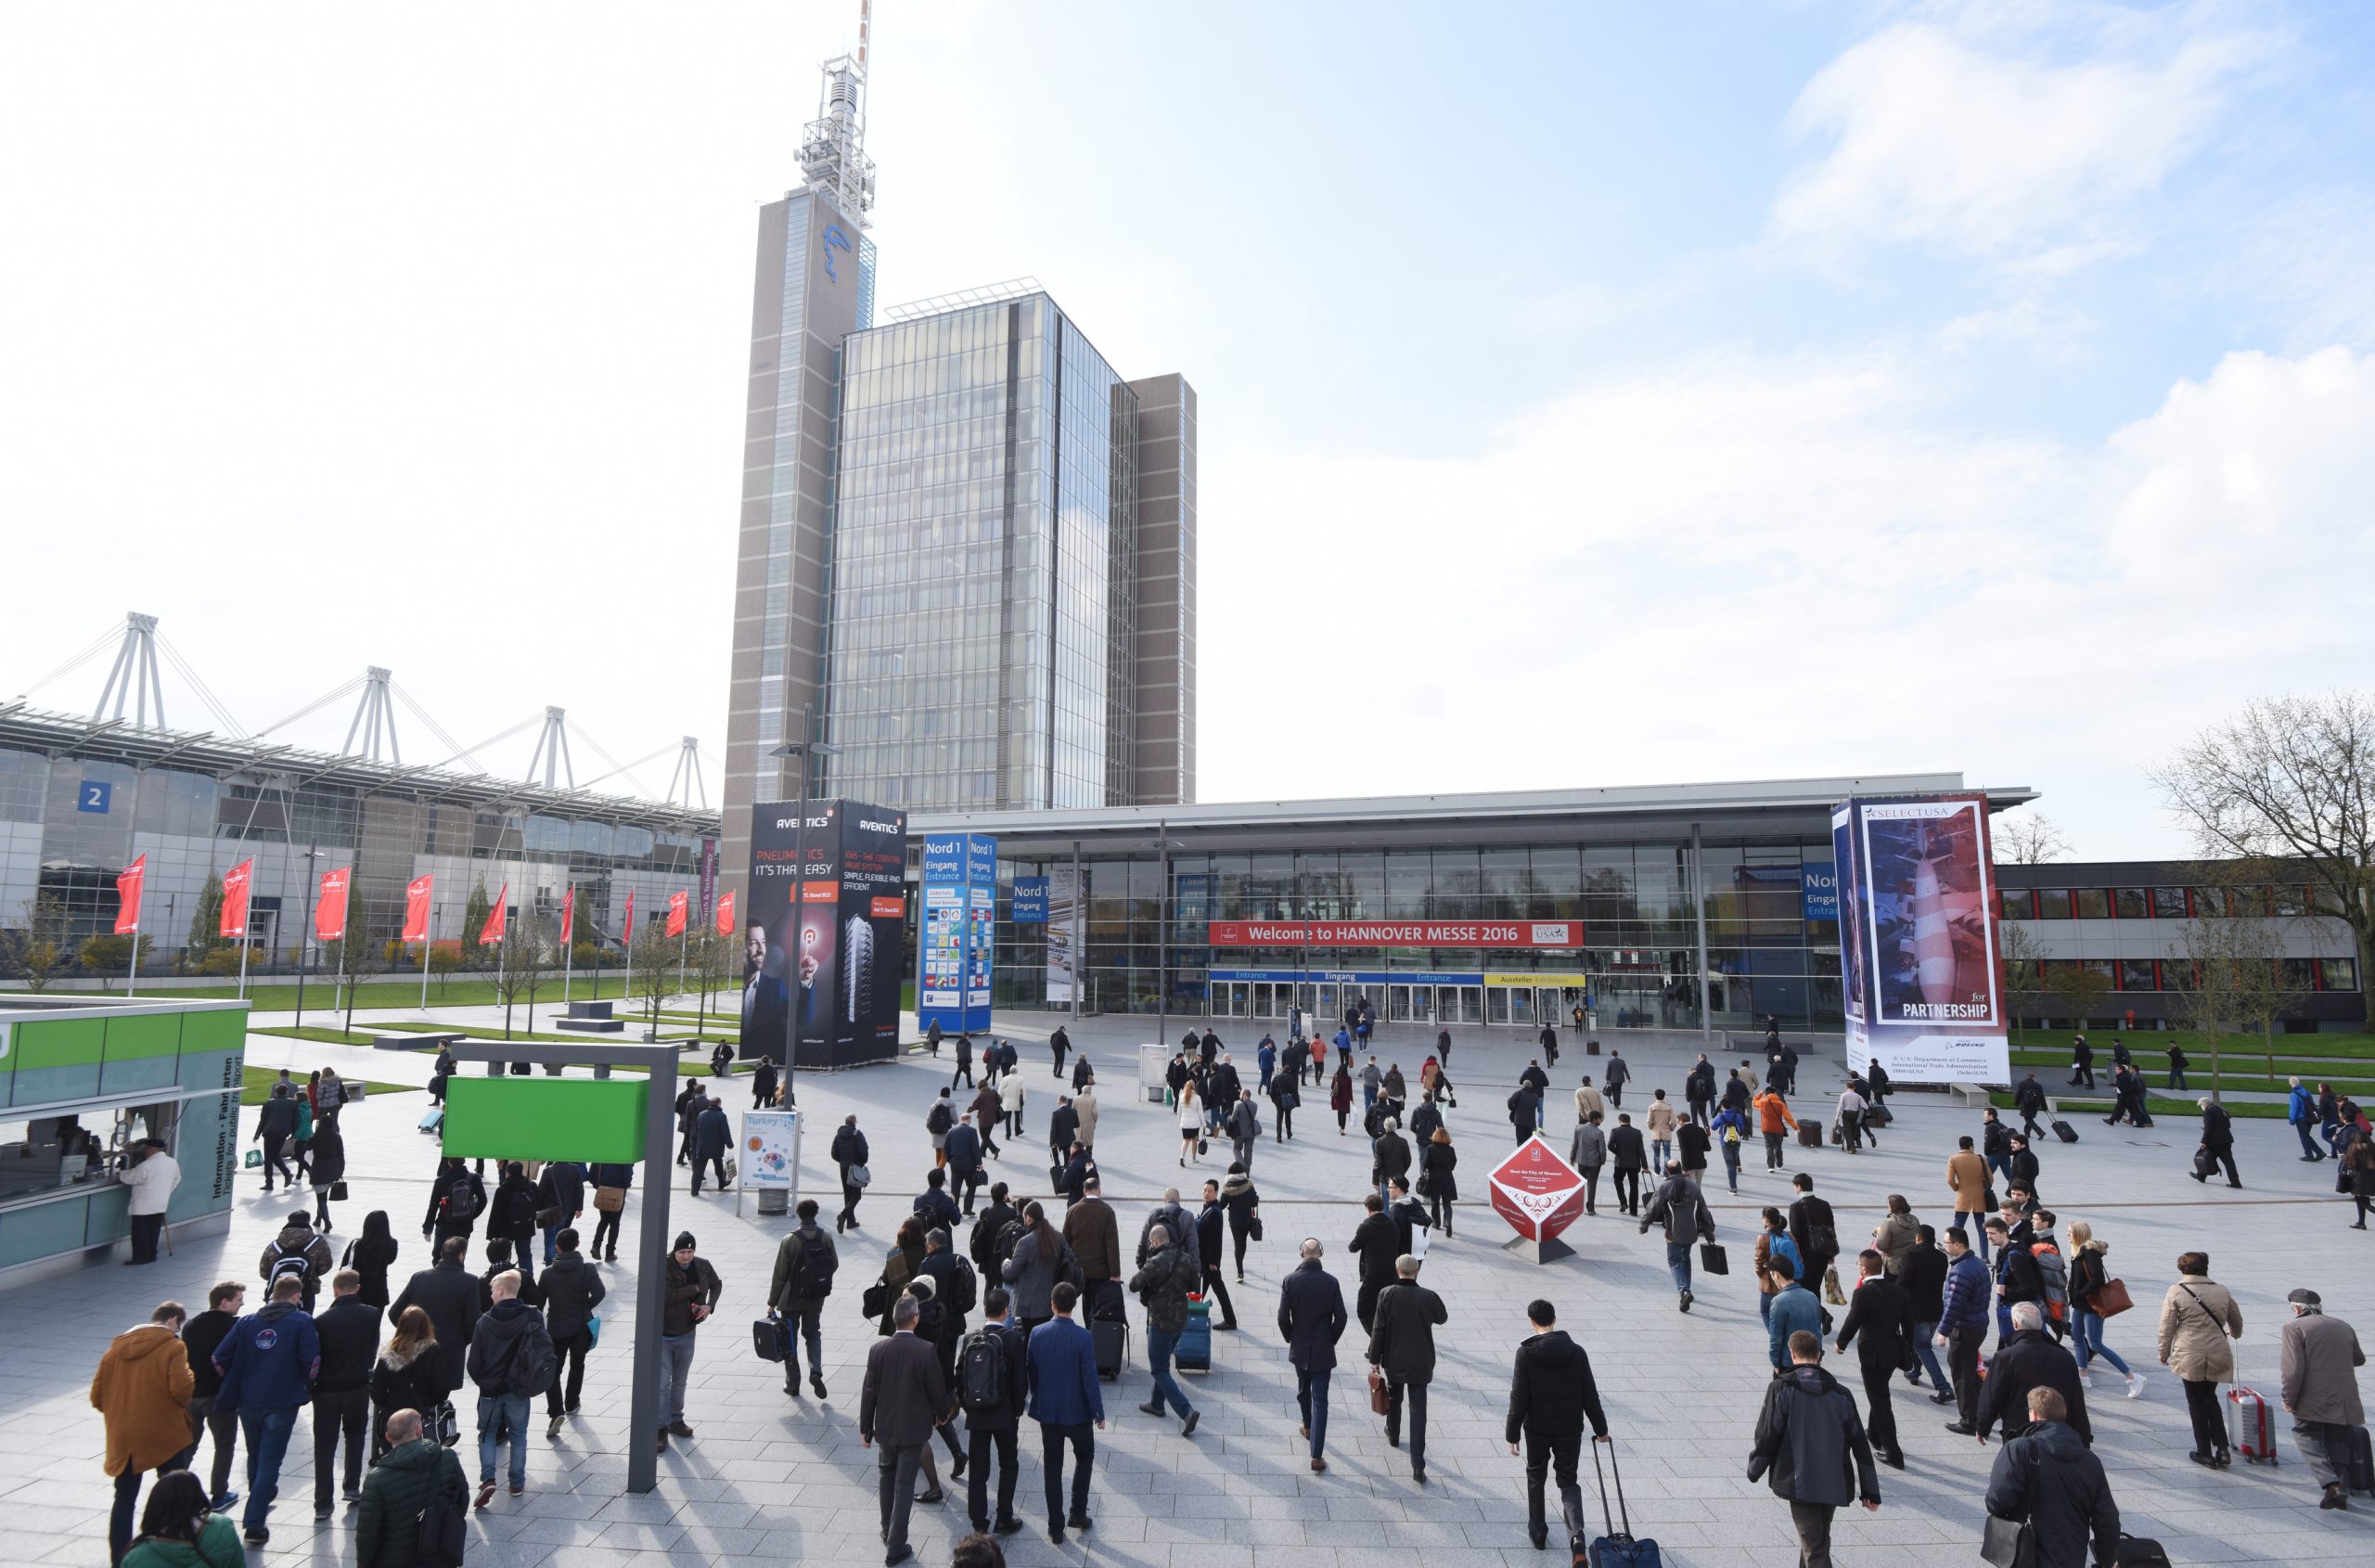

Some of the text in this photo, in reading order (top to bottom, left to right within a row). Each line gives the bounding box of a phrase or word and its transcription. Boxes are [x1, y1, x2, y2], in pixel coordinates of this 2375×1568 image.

[88, 789, 101, 805] 2
[1878, 808, 1948, 817] SELECTUSA
[860, 820, 897, 834] AVENTICS
[926, 842, 960, 854] Nord 1
[970, 842, 993, 855] Nord 1
[755, 863, 832, 876] IT'S THA EASY
[926, 861, 958, 871] Eingang
[970, 861, 991, 872] Eingang
[704, 853, 713, 892] Technology
[843, 871, 901, 883] SIMPLE, FLEXIBLE AND
[925, 872, 959, 880] Entrance
[970, 872, 992, 881] Entrance
[843, 881, 870, 891] EFFICIENT
[1014, 885, 1048, 897] Nord 1
[1014, 902, 1040, 911] Eingang
[1249, 926, 1519, 941] Welcome to HANNOVER MESSE 2016
[1325, 972, 1355, 983] Eingang
[1971, 993, 1986, 1002] for
[1903, 1003, 1987, 1018] PARTNERSHIP
[232, 1056, 242, 1103] transport
[748, 1116, 777, 1126] Turkey
[226, 1142, 235, 1156] for
[212, 1131, 226, 1199] Information
[223, 1160, 233, 1196] Tickets
